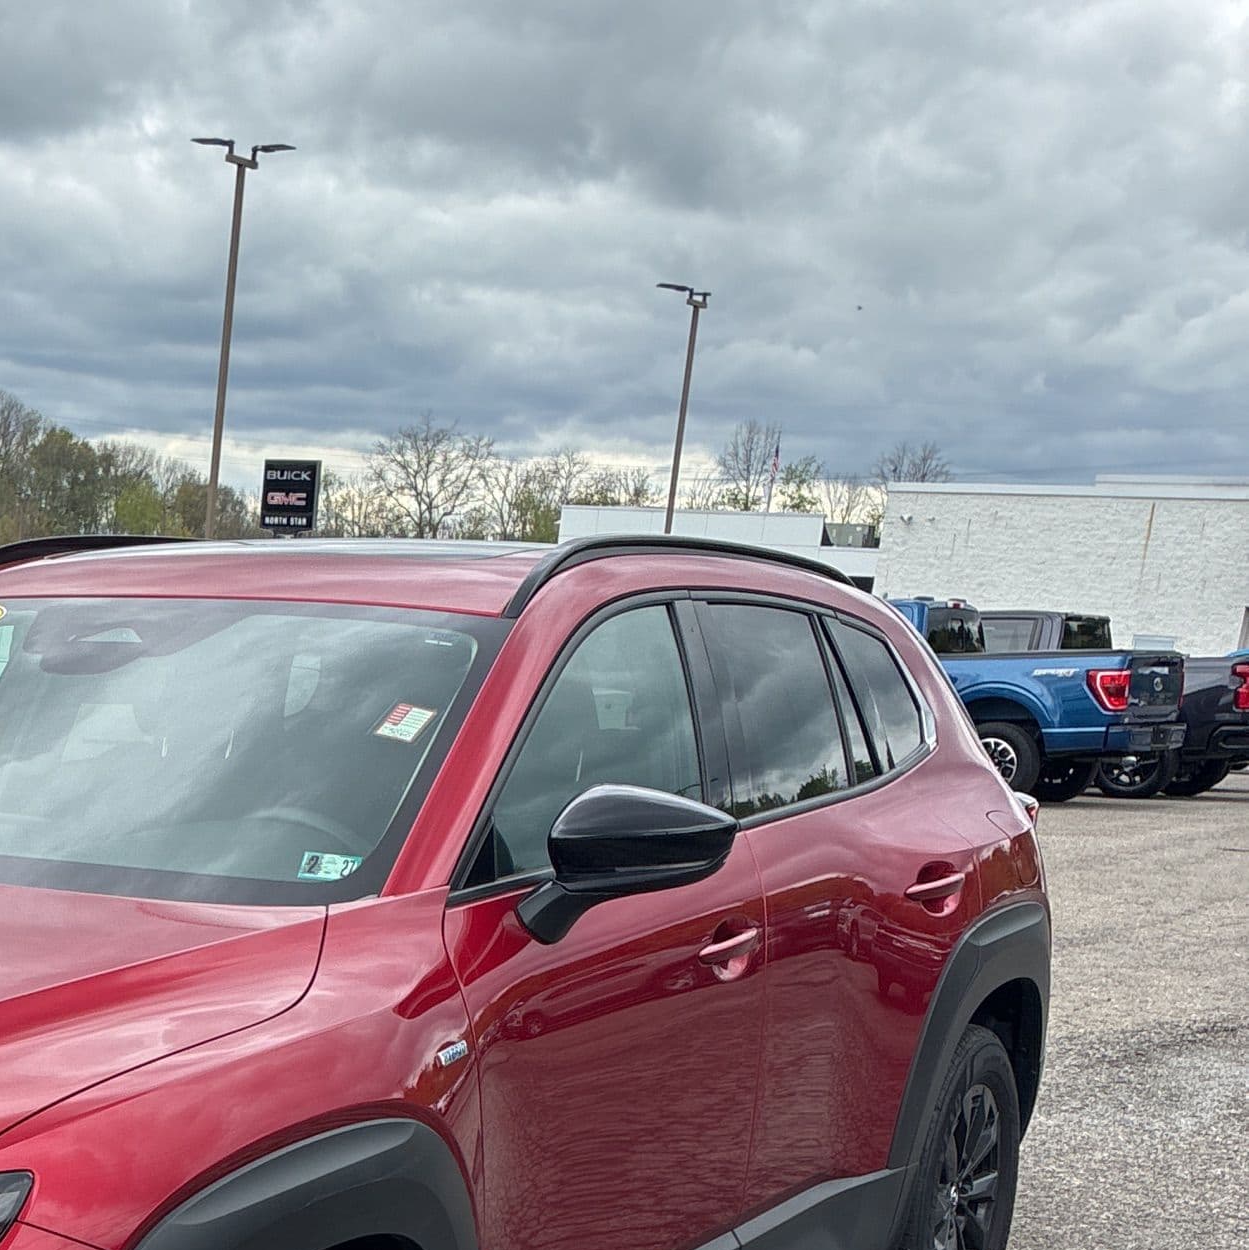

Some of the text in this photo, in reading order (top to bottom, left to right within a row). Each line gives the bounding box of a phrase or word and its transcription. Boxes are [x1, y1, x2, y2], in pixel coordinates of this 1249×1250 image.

[266, 470, 311, 480] BUICK
[266, 492, 307, 506] GMC
[264, 516, 307, 526] NORTH STAR
